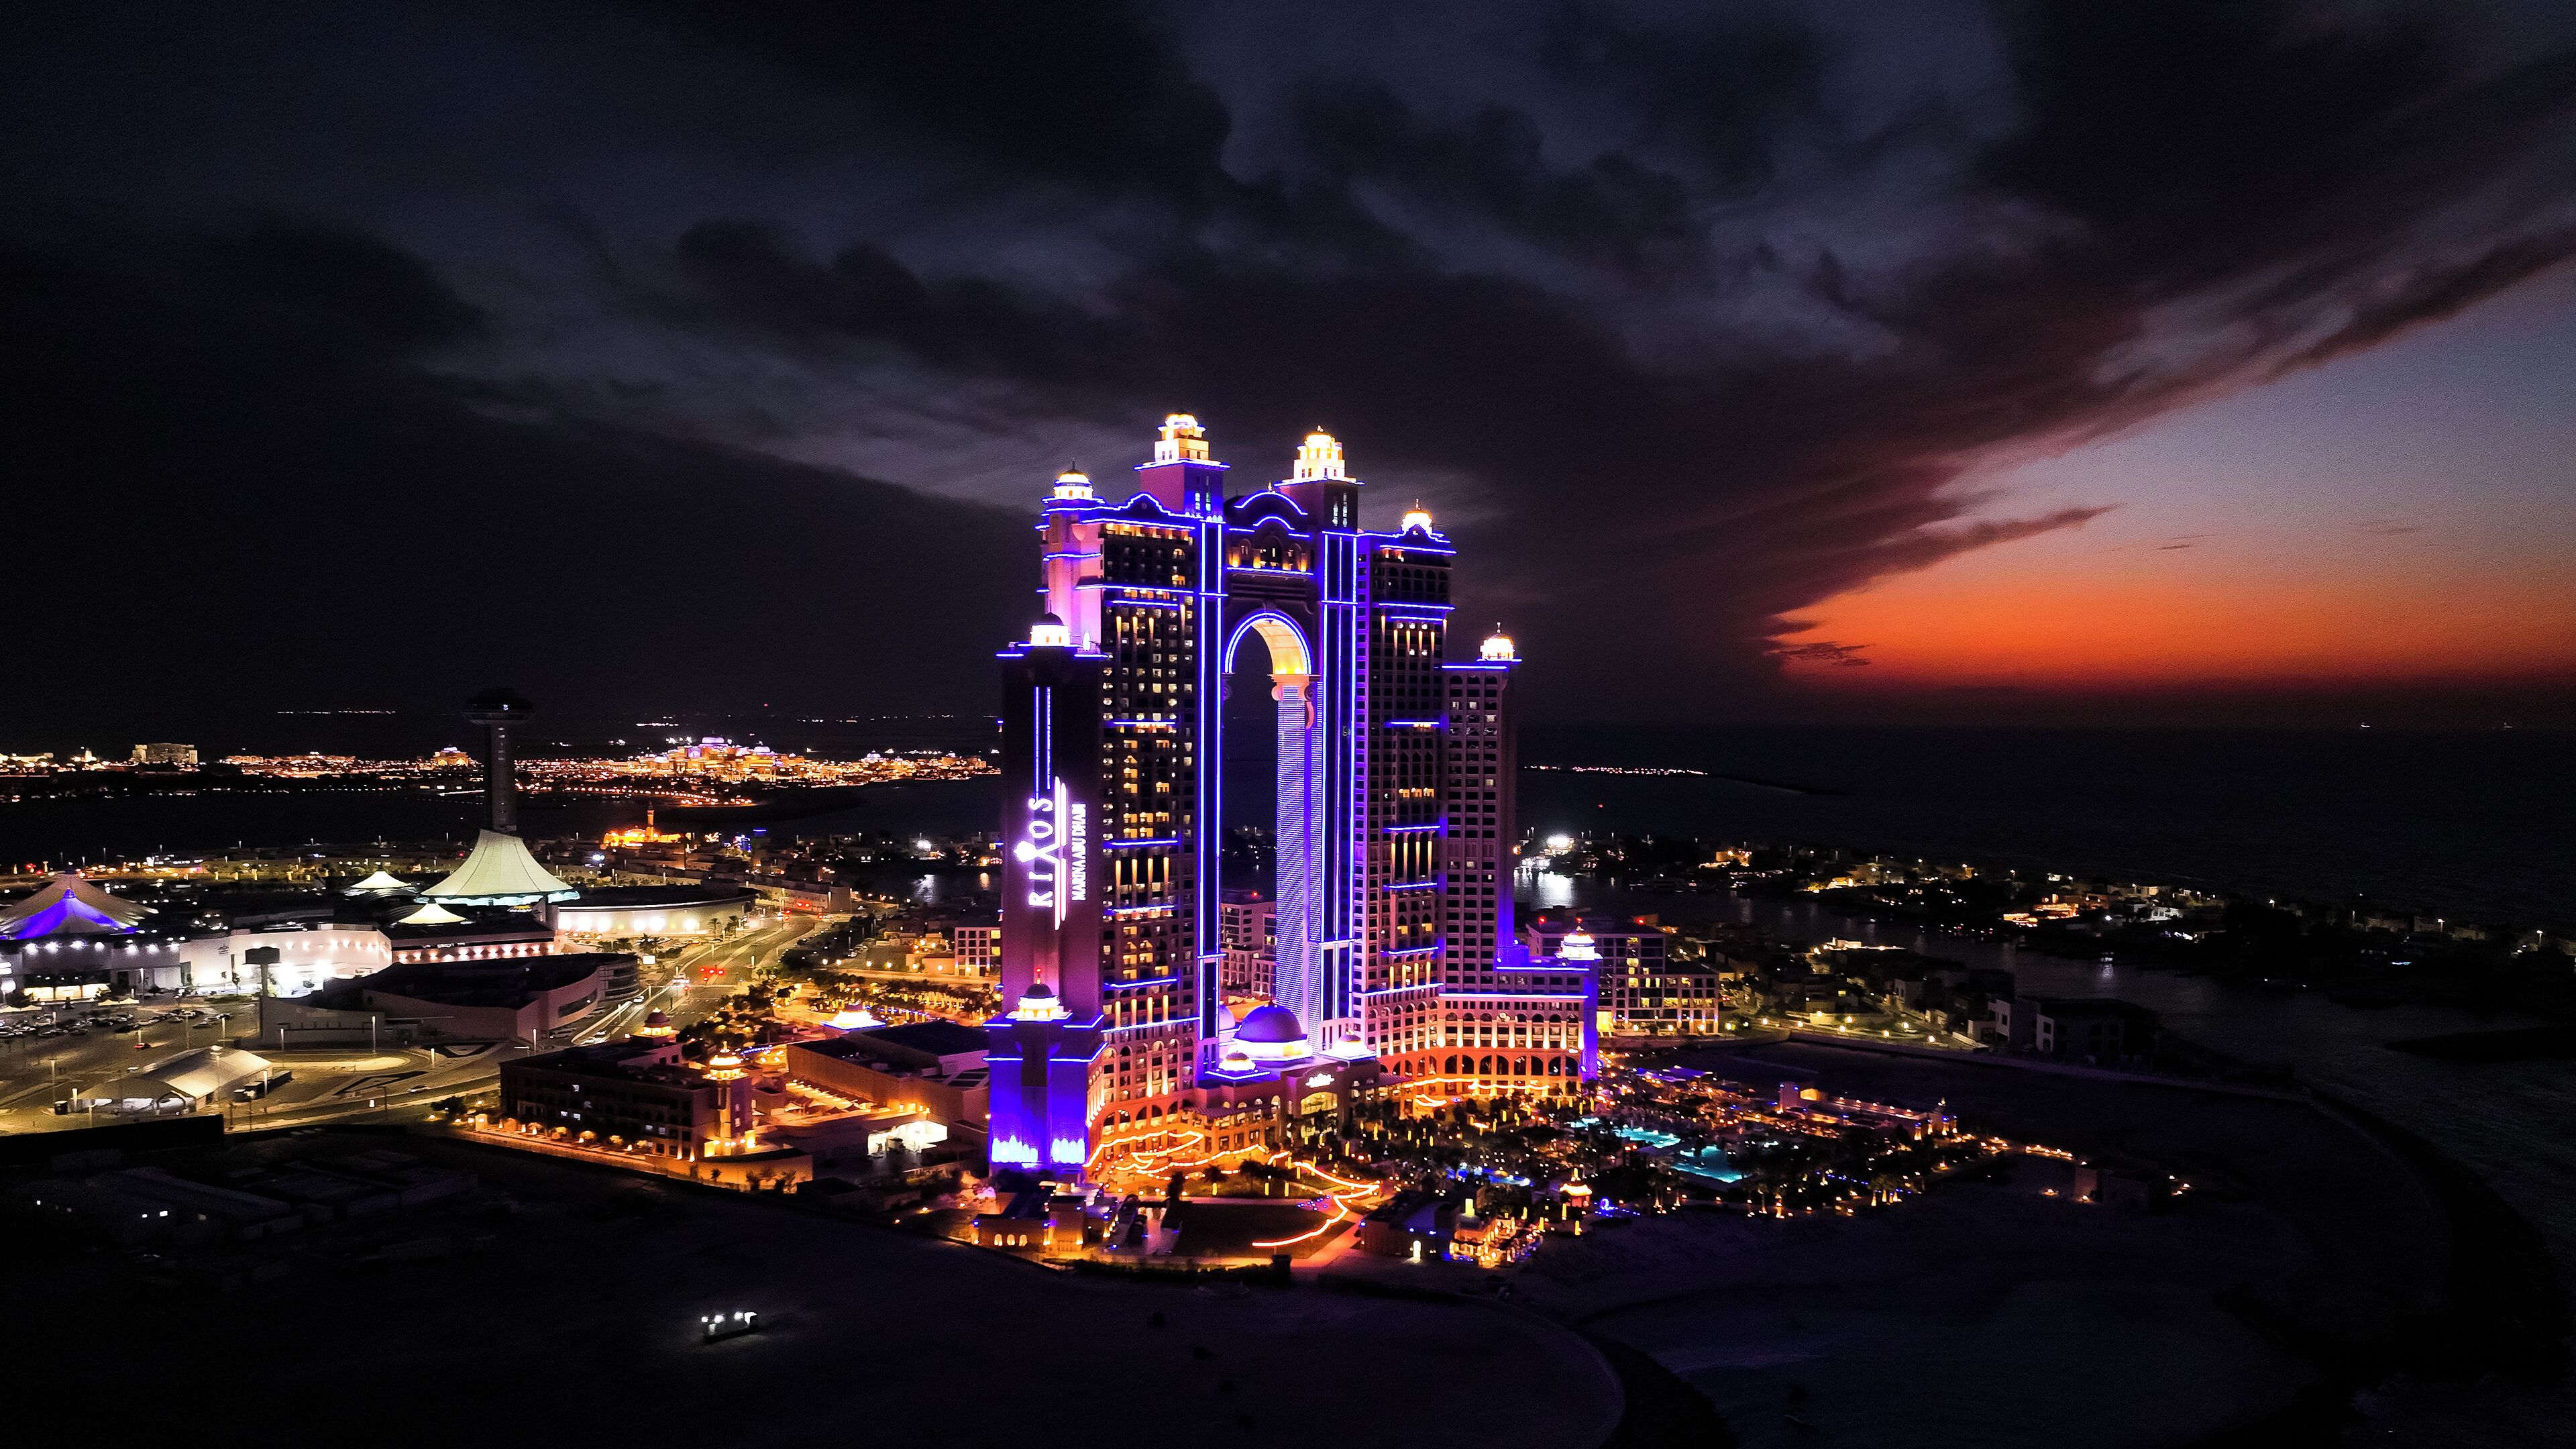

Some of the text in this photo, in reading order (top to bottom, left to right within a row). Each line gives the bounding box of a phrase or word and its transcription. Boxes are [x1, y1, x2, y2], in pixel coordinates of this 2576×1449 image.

[1014, 798, 1057, 908] RIXOS
[1071, 804, 1086, 901] MARINA ABU DHABI
